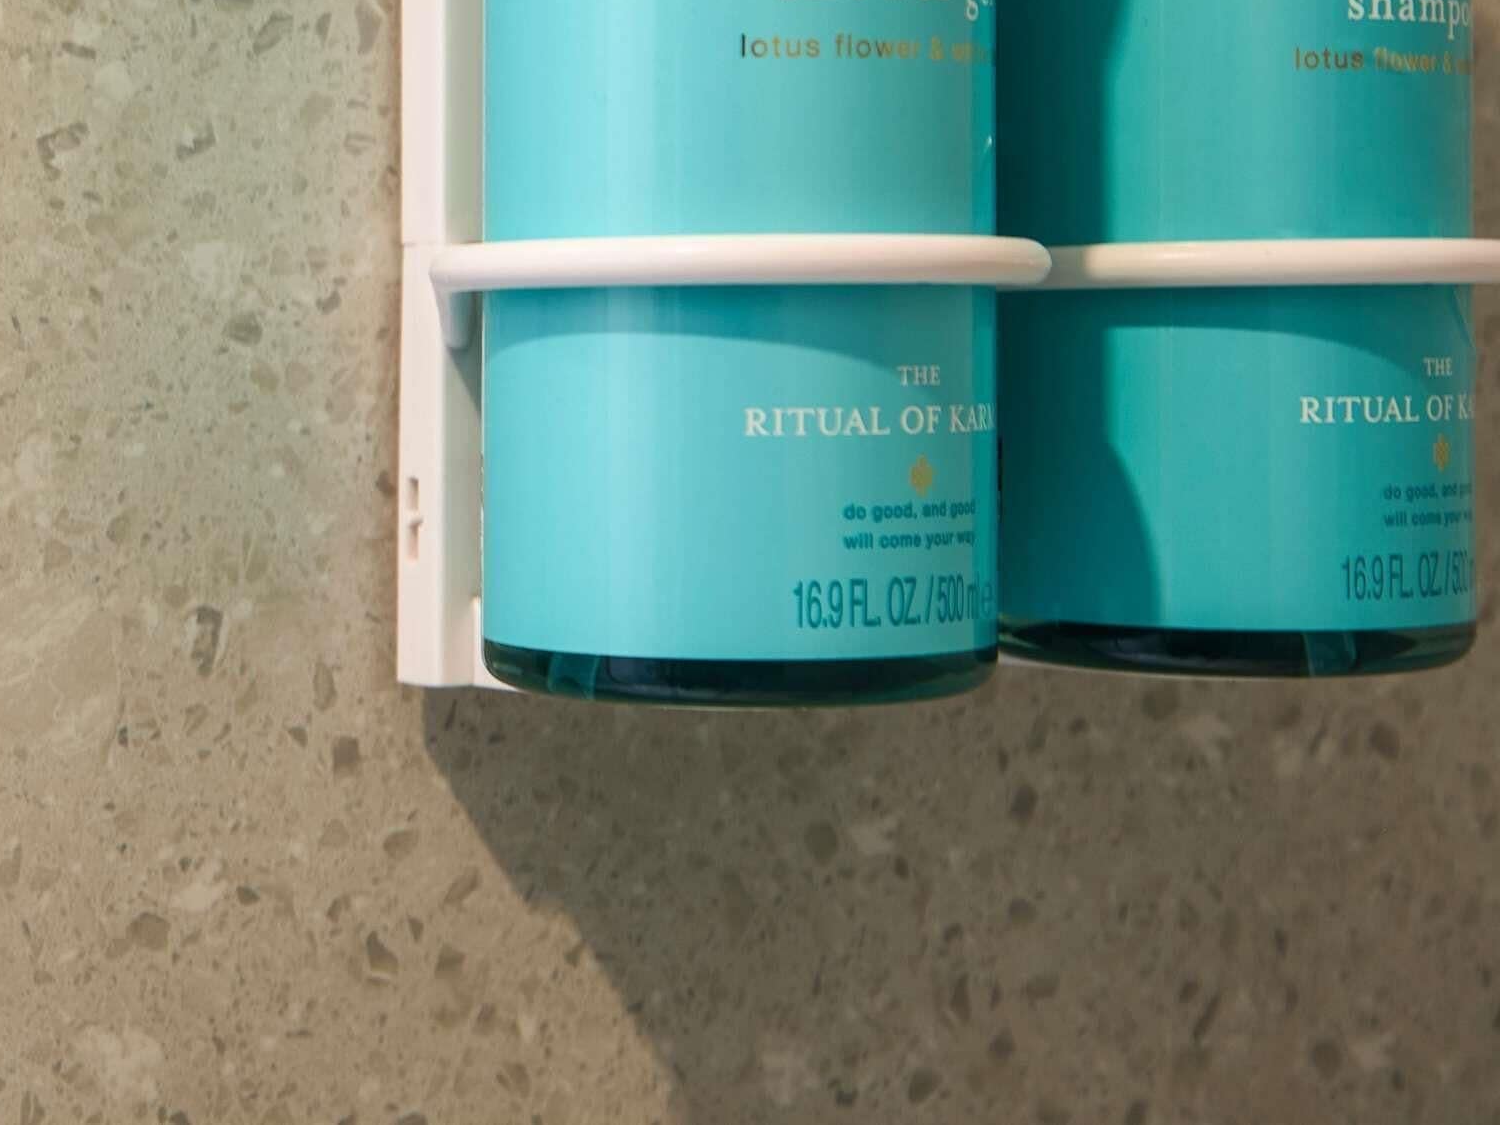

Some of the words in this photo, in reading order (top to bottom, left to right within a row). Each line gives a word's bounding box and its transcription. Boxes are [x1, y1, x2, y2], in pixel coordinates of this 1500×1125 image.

[740, 32, 821, 59] lotus
[835, 32, 921, 60] flower
[1295, 46, 1364, 71] lotus
[897, 364, 941, 388] THE
[1422, 357, 1453, 377] THE
[744, 407, 891, 437] RITUAL
[900, 405, 942, 435] OF
[1300, 395, 1420, 424] RITUAL
[1426, 394, 1454, 421] OF
[1383, 483, 1401, 500] do
[843, 502, 867, 521] do
[871, 501, 918, 524] good,
[922, 500, 947, 518] and
[1384, 510, 1407, 527] will
[843, 531, 874, 550] will
[879, 532, 922, 549] come
[926, 531, 953, 550] your
[1342, 554, 1384, 601] 16.9
[793, 578, 844, 629] 16.9
[850, 578, 882, 628] FL.
